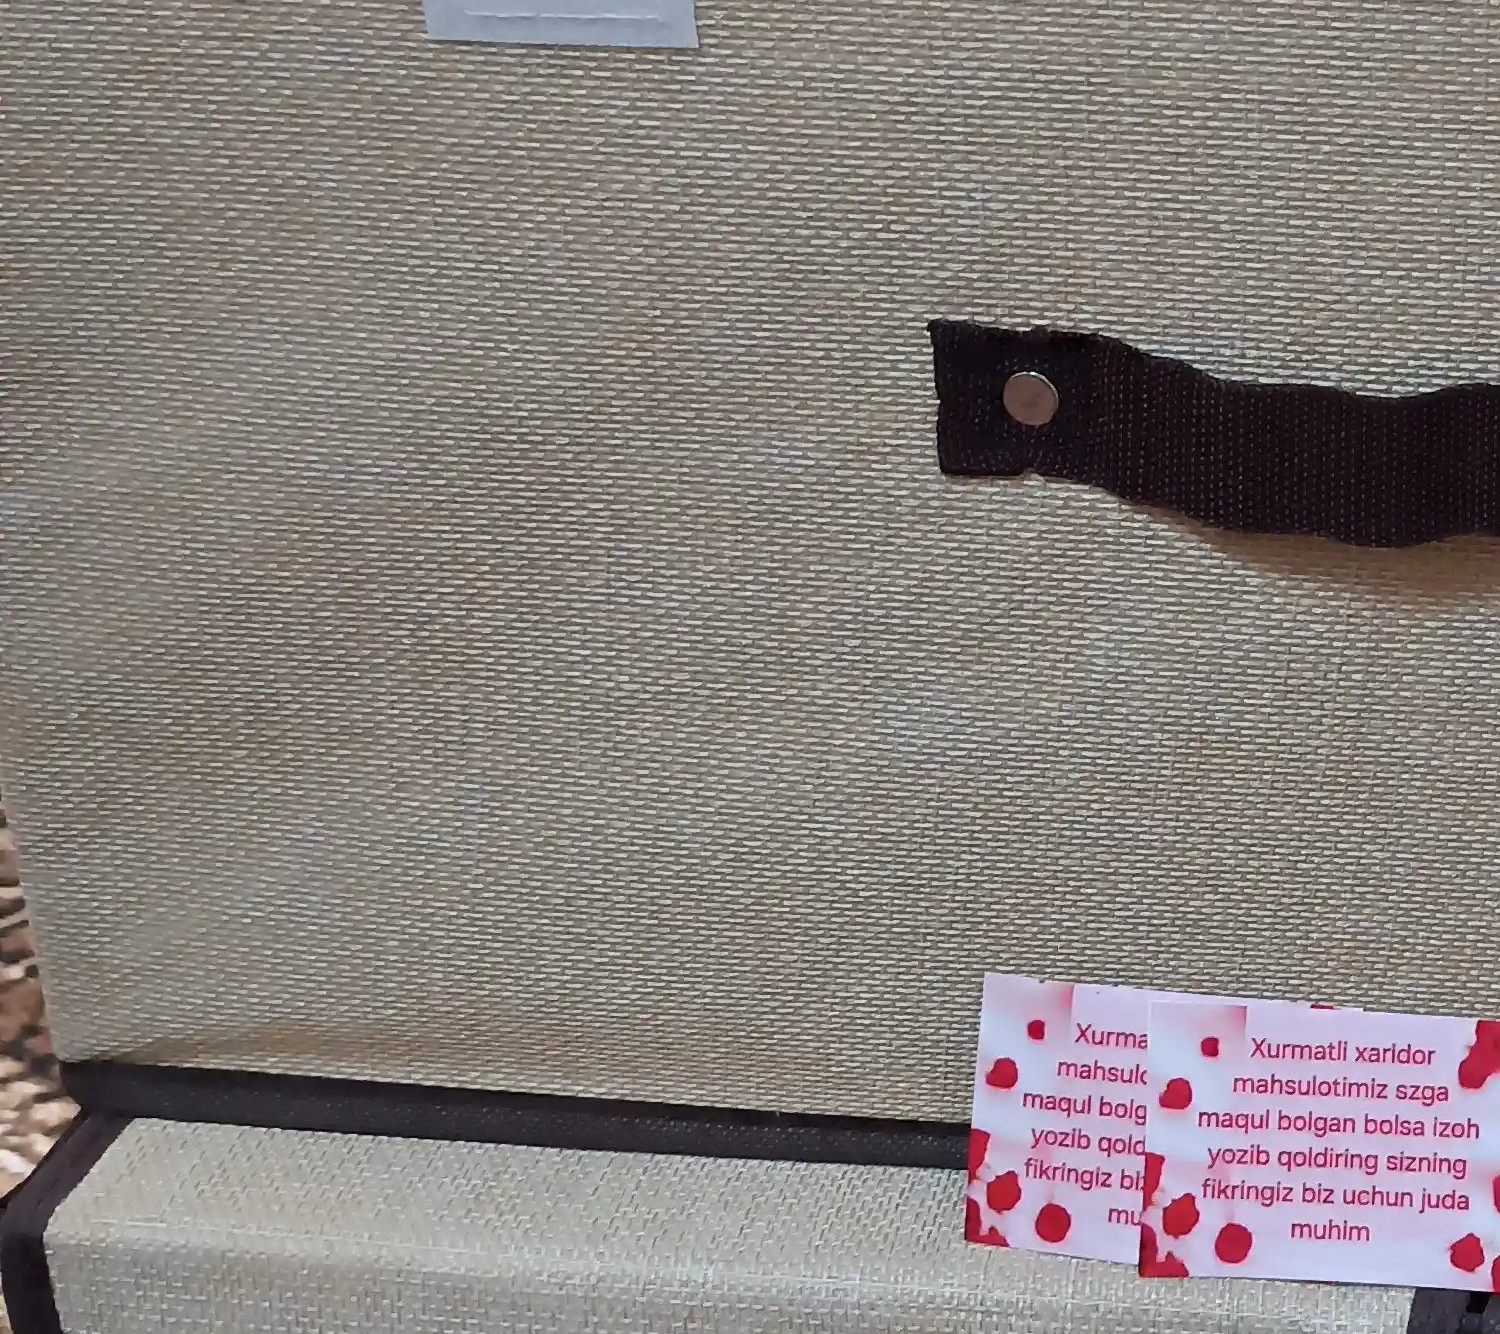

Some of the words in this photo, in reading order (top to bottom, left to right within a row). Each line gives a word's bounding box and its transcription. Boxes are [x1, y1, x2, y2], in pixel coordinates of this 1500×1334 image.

[1250, 1037, 1347, 1061] Xurmatli
[1354, 1043, 1436, 1065] xaridor
[1233, 1074, 1388, 1099] mahsulotimiz
[1396, 1084, 1449, 1106] szga
[1023, 1092, 1091, 1117] maqul
[1099, 1096, 1147, 1126] bolg
[1198, 1109, 1270, 1134] maqul
[1278, 1110, 1355, 1137] bolgan
[1364, 1113, 1424, 1136] bolsa
[1433, 1117, 1479, 1139] izoh
[1030, 1128, 1090, 1149] yozib
[1025, 1158, 1112, 1190] fikringiz
[1207, 1145, 1270, 1169] yozib
[1278, 1147, 1378, 1175] qoldiring
[1386, 1151, 1467, 1179] sizning
[1202, 1179, 1293, 1207] fikringiz
[1302, 1183, 1334, 1204] biz
[1343, 1185, 1413, 1207] uchun
[1419, 1188, 1470, 1213] juda
[1291, 1219, 1370, 1241] muhim
